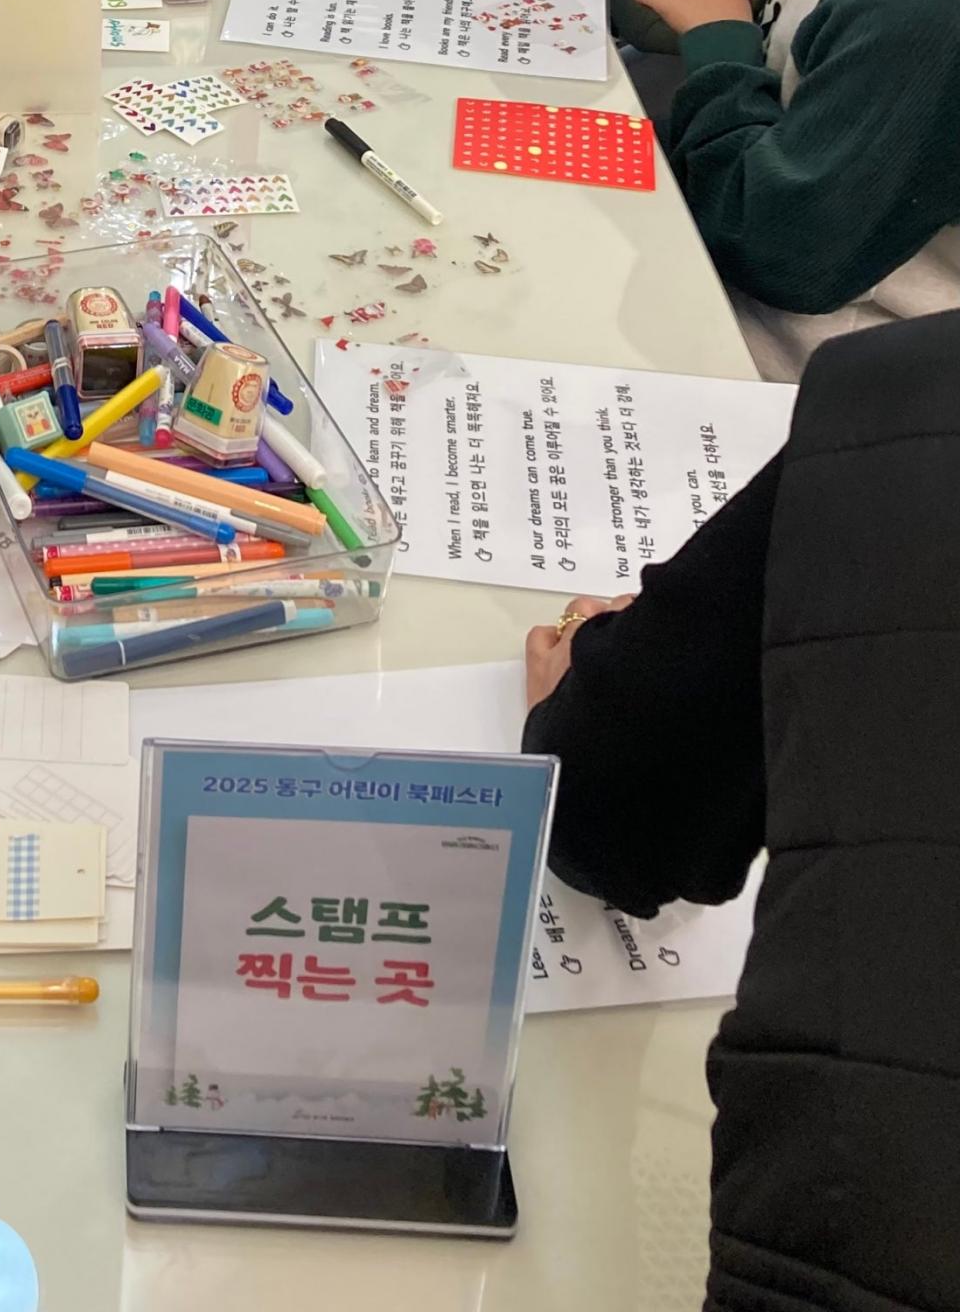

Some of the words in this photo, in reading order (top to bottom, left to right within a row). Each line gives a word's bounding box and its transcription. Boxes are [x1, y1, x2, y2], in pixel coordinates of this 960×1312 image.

[268, 12, 277, 20] do
[269, 4, 279, 12] it.
[342, 7, 357, 26] 읽기는
[401, 13, 414, 25] 책을
[265, 20, 274, 33] can
[283, 16, 296, 28] 나는
[381, 13, 394, 31] books.
[442, 23, 450, 34] are
[443, 15, 454, 25] my
[459, 21, 472, 34] 나의
[320, 20, 337, 43] Reading
[381, 31, 391, 46] love
[399, 28, 412, 39] 나는
[457, 35, 471, 47] 책은
[501, 31, 513, 46] every
[518, 27, 532, 39] 책을
[438, 34, 449, 56] Books
[498, 48, 509, 63] Read
[518, 41, 531, 54] 매일
[366, 382, 380, 414] dream.
[540, 376, 557, 405] 있어요.
[390, 393, 406, 412] 책을
[466, 381, 484, 432] 똑똑해져요.
[544, 407, 560, 418] 수
[619, 406, 635, 417] 더
[444, 396, 457, 434] smarter.
[522, 409, 534, 430] true.
[595, 406, 611, 432] think.
[366, 417, 380, 436] and
[391, 416, 406, 437] 위해
[620, 420, 641, 452] 것보다
[366, 439, 380, 464] learn
[469, 438, 485, 448] 더
[525, 434, 537, 462] come
[544, 421, 565, 460] 이루어질
[603, 434, 618, 455] you
[700, 422, 722, 464] 다하세요.
[391, 441, 407, 470] 꿈꾸기
[445, 438, 458, 478] become
[469, 454, 485, 475] 나는
[369, 467, 380, 479] to
[528, 466, 539, 484] can
[548, 465, 566, 485] 꿈은
[604, 457, 618, 482] than
[627, 456, 649, 500] 생각하는
[687, 468, 699, 490] can.
[391, 476, 407, 506] 배우고
[472, 480, 489, 512] 읽으면
[708, 469, 729, 504] 최선을
[445, 490, 460, 516] read,
[528, 488, 542, 526] dreams
[551, 490, 568, 512] 모든
[609, 485, 625, 530] stronger
[692, 494, 708, 517] you
[633, 505, 651, 529] 네가
[472, 518, 489, 541] 책을
[534, 530, 544, 550] our
[553, 516, 573, 550] 우리의
[448, 529, 462, 560] When
[615, 534, 627, 553] are
[638, 535, 655, 560] 너는
[531, 554, 546, 570] All
[616, 557, 630, 578] You
[203, 776, 268, 794] 2025
[275, 777, 322, 798] 동구
[328, 779, 401, 802] 어린이
[406, 783, 504, 807] 북페스타
[245, 895, 433, 945] 스탬프
[615, 918, 647, 971] Dream
[236, 953, 356, 1002] 찍는
[374, 960, 435, 1007] 곳
